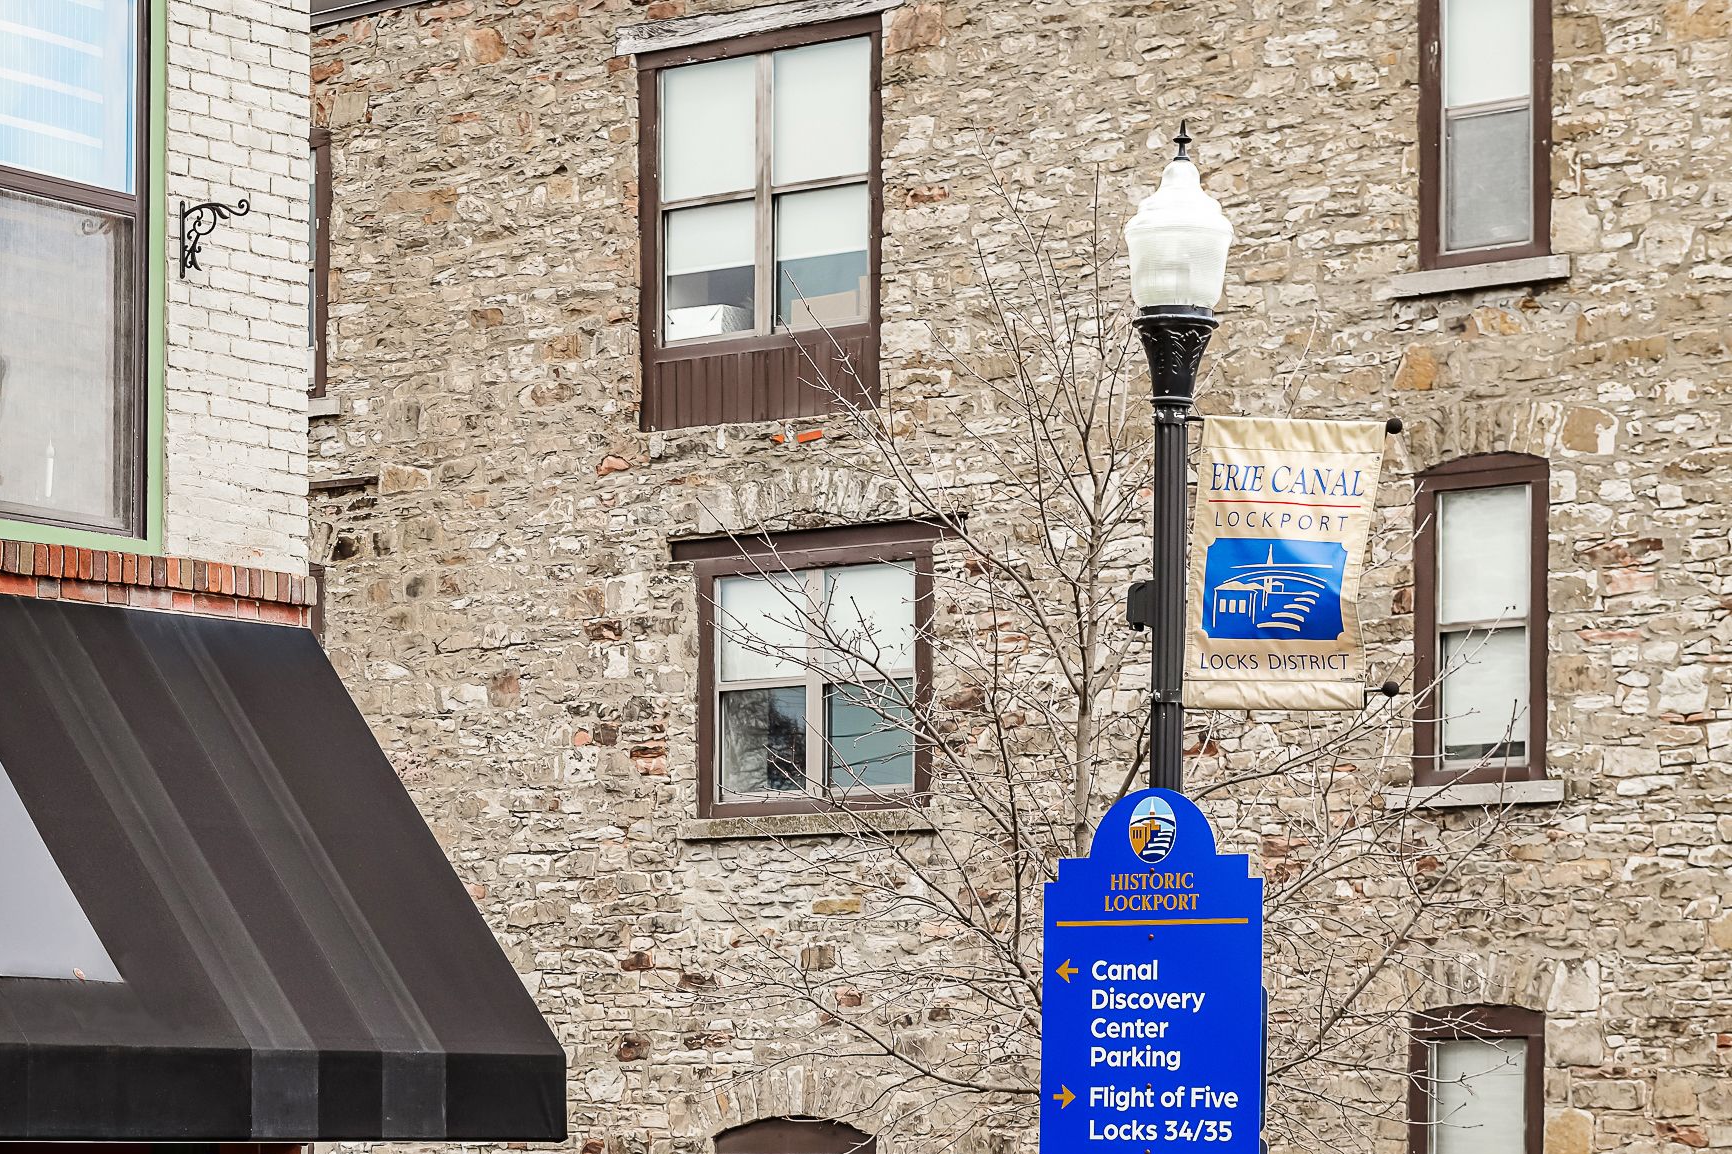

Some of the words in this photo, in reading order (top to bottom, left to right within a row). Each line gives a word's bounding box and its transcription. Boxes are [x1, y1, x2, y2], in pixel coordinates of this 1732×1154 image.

[1209, 462, 1266, 492] ERIE
[1271, 465, 1365, 497] CANAL
[1215, 511, 1350, 532] LOCKPORT
[1200, 652, 1259, 670] LOCKS
[1267, 653, 1350, 670] DISTRICT
[1110, 871, 1195, 892] HISTORIC
[1104, 893, 1200, 912] LOCKPORT
[1091, 959, 1158, 981] Canal
[1091, 986, 1206, 1013] Discovery
[1090, 1017, 1169, 1039] Center
[1090, 1044, 1181, 1072] Parking
[1089, 1085, 1155, 1111] Flight
[1160, 1085, 1186, 1108] of
[1190, 1085, 1239, 1109] Five
[1089, 1119, 1158, 1142] Locks
[1163, 1119, 1234, 1142] 34/35
